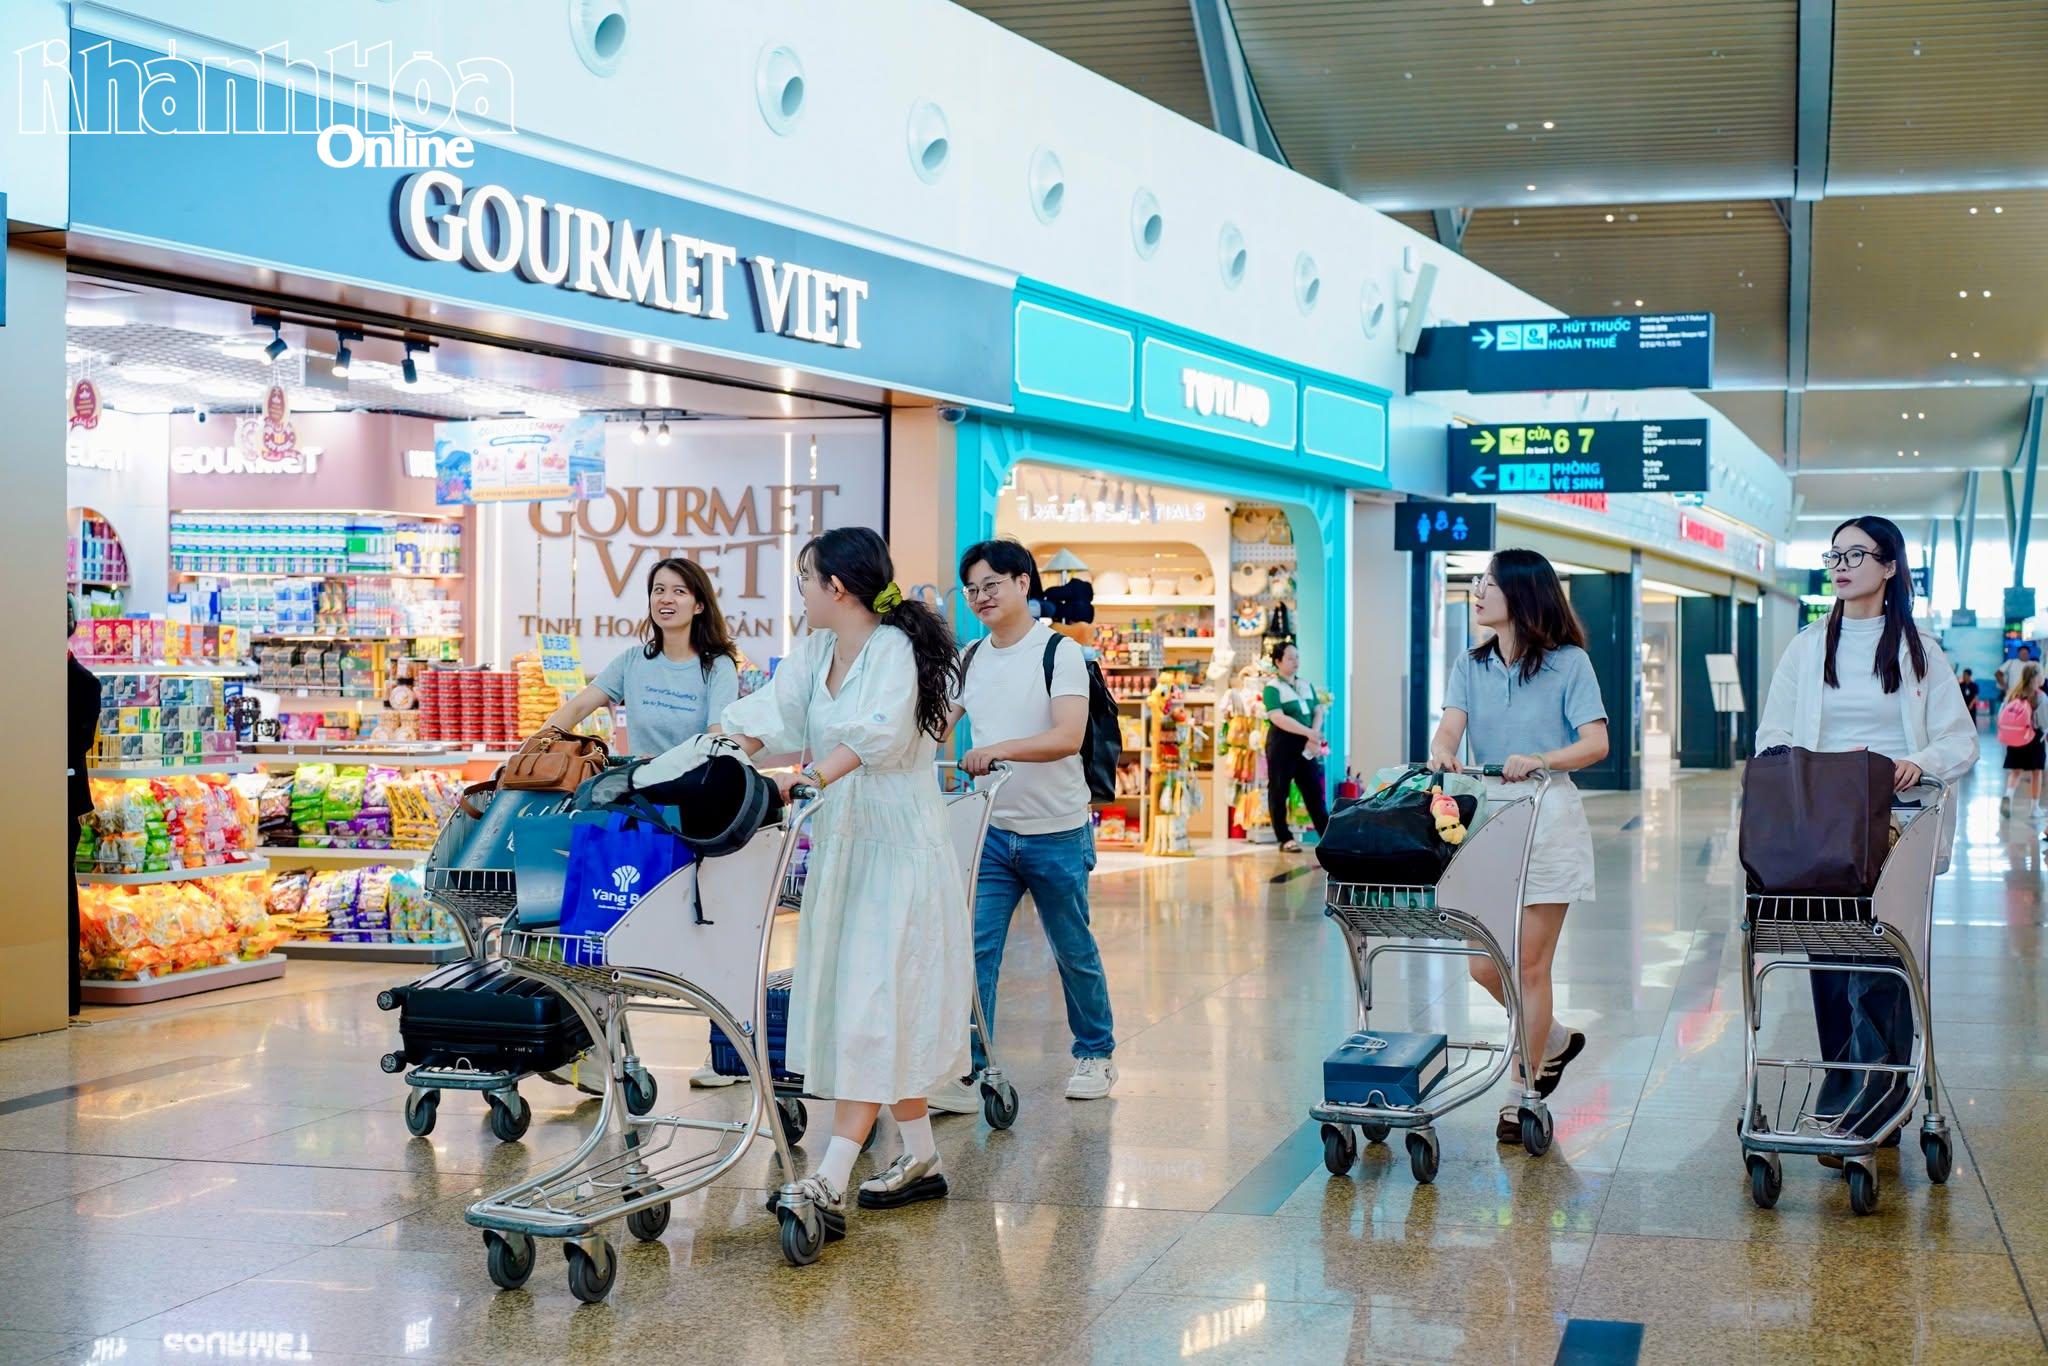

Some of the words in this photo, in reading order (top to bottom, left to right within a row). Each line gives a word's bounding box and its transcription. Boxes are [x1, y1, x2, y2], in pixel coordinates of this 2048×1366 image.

[397, 170, 737, 321] GOURMET
[745, 255, 869, 350] VIET
[1562, 320, 1588, 334] HÚT
[1589, 317, 1632, 333] THUỐC
[1548, 336, 1583, 350] HOÀN
[1584, 333, 1618, 349] THUẾ
[1527, 425, 1552, 441] CỬA
[1553, 428, 1571, 454] 6
[1578, 428, 1595, 454] 7
[1552, 461, 1601, 476] PHÒNG
[1552, 476, 1571, 492] VỆ
[1571, 477, 1604, 490] SINH
[527, 484, 840, 538] GOURMET
[592, 888, 627, 907] Yang
